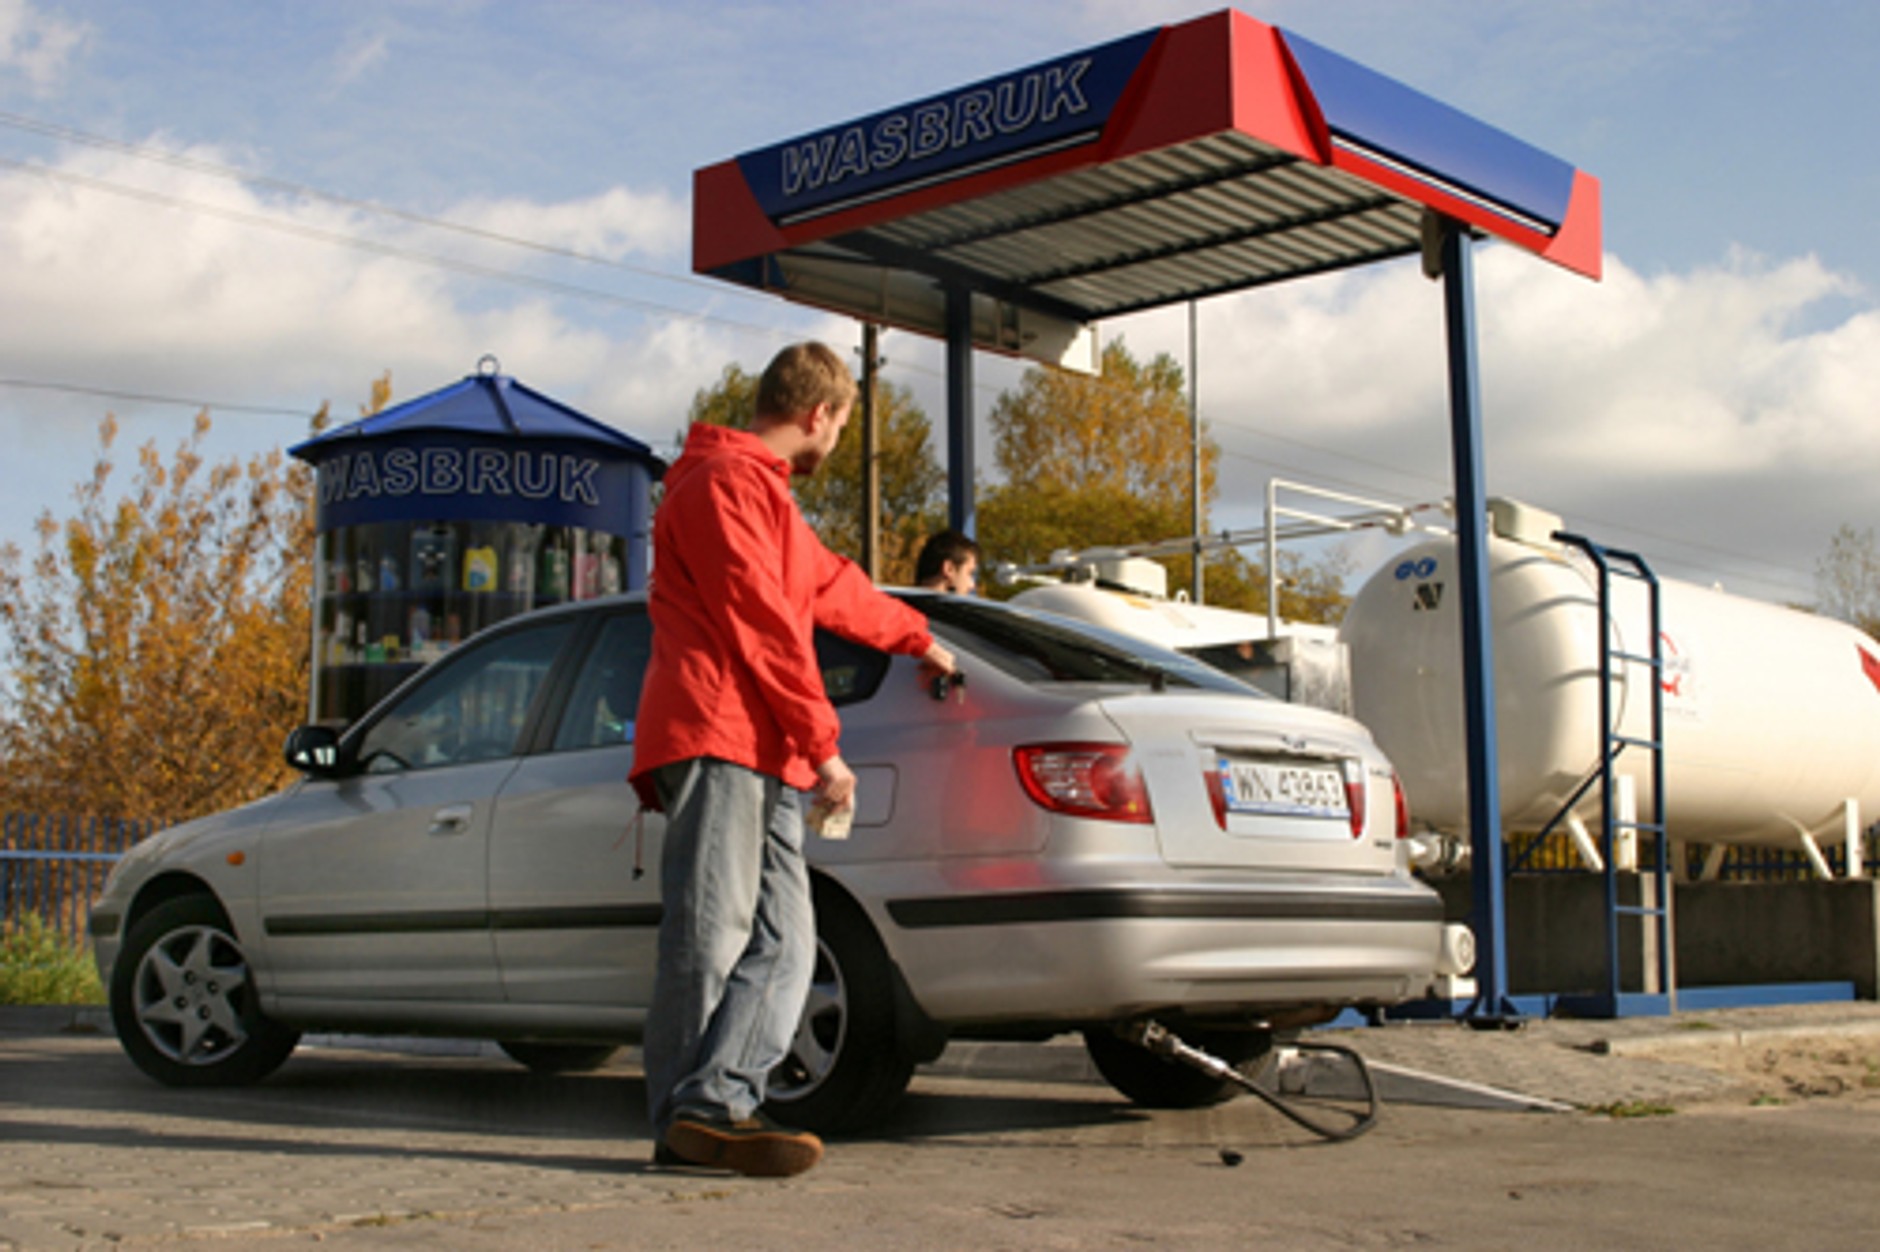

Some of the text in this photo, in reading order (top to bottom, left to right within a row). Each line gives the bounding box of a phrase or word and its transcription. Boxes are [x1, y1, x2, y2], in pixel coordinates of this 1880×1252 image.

[780, 57, 1093, 196] WASBRUK
[319, 447, 600, 506] WASBRUK
[1233, 766, 1273, 802] WN
